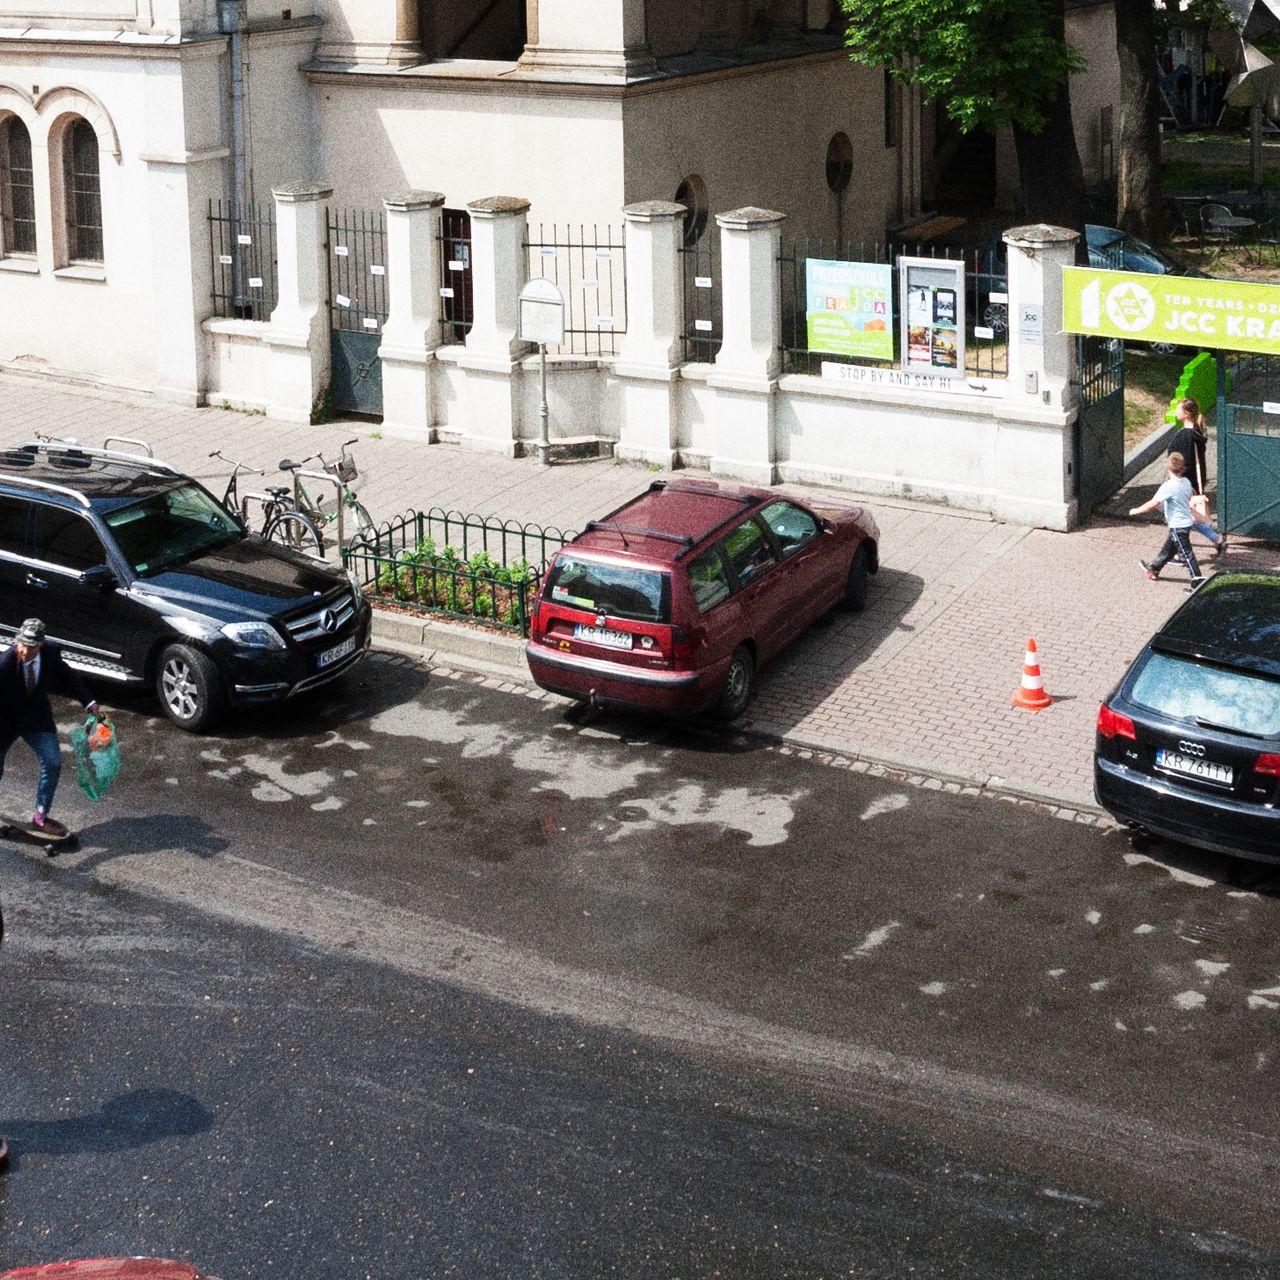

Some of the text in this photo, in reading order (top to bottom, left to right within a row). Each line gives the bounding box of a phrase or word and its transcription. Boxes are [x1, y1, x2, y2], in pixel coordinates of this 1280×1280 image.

[1165, 294, 1191, 307] TEN
[1198, 297, 1244, 311] YEARS
[1164, 310, 1218, 335] JCC
[840, 366, 866, 381] STOP
[871, 370, 884, 383] BY
[889, 373, 910, 386] AND
[914, 376, 936, 389] SAY
[1164, 750, 1232, 781] KR 761TY
